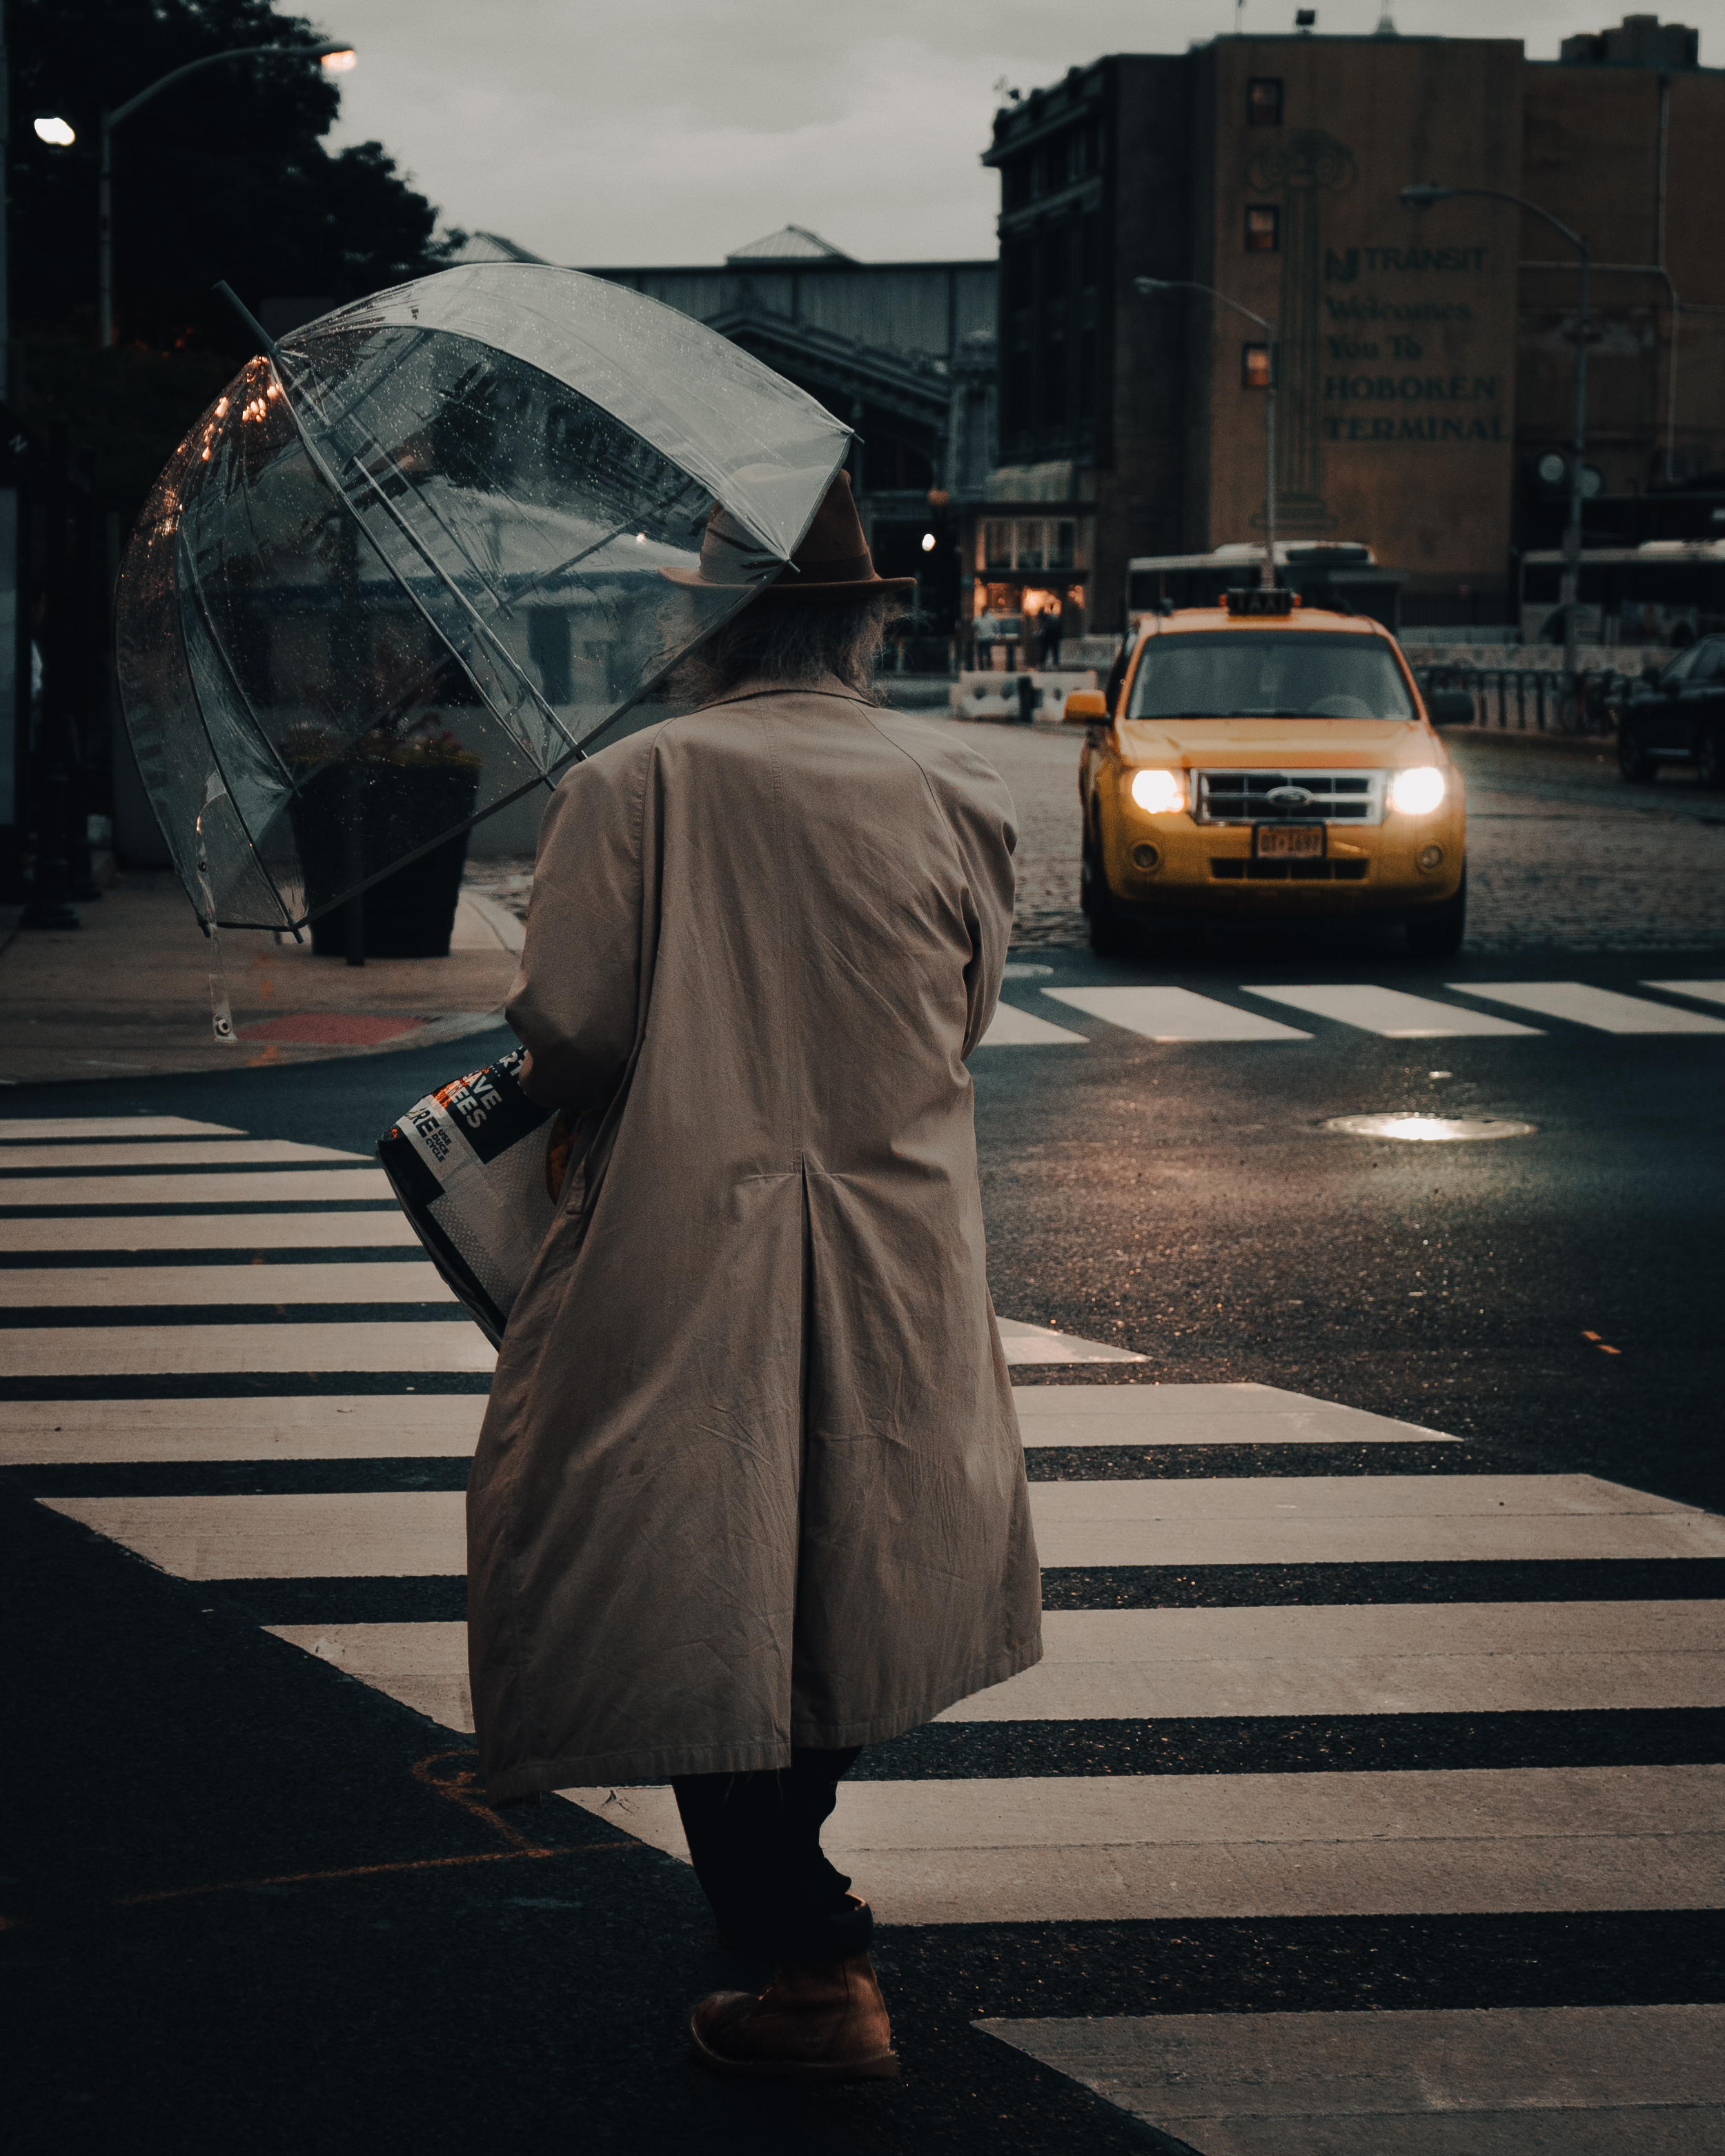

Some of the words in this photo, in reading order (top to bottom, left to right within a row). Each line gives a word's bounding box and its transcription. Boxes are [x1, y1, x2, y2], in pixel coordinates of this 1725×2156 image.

[1323, 247, 1359, 282] NJ
[1363, 247, 1487, 272] TRANSIT
[1325, 296, 1472, 321] Welcomes
[1325, 334, 1379, 359] You
[1386, 334, 1423, 360] To
[1323, 375, 1497, 401] HOBOKEN
[1323, 416, 1512, 442] TERMINAL
[1233, 594, 1287, 611] TAXI
[431, 1133, 449, 1156] DUCE
[438, 1129, 452, 1146] USE
[426, 1138, 445, 1163] CYCLE
